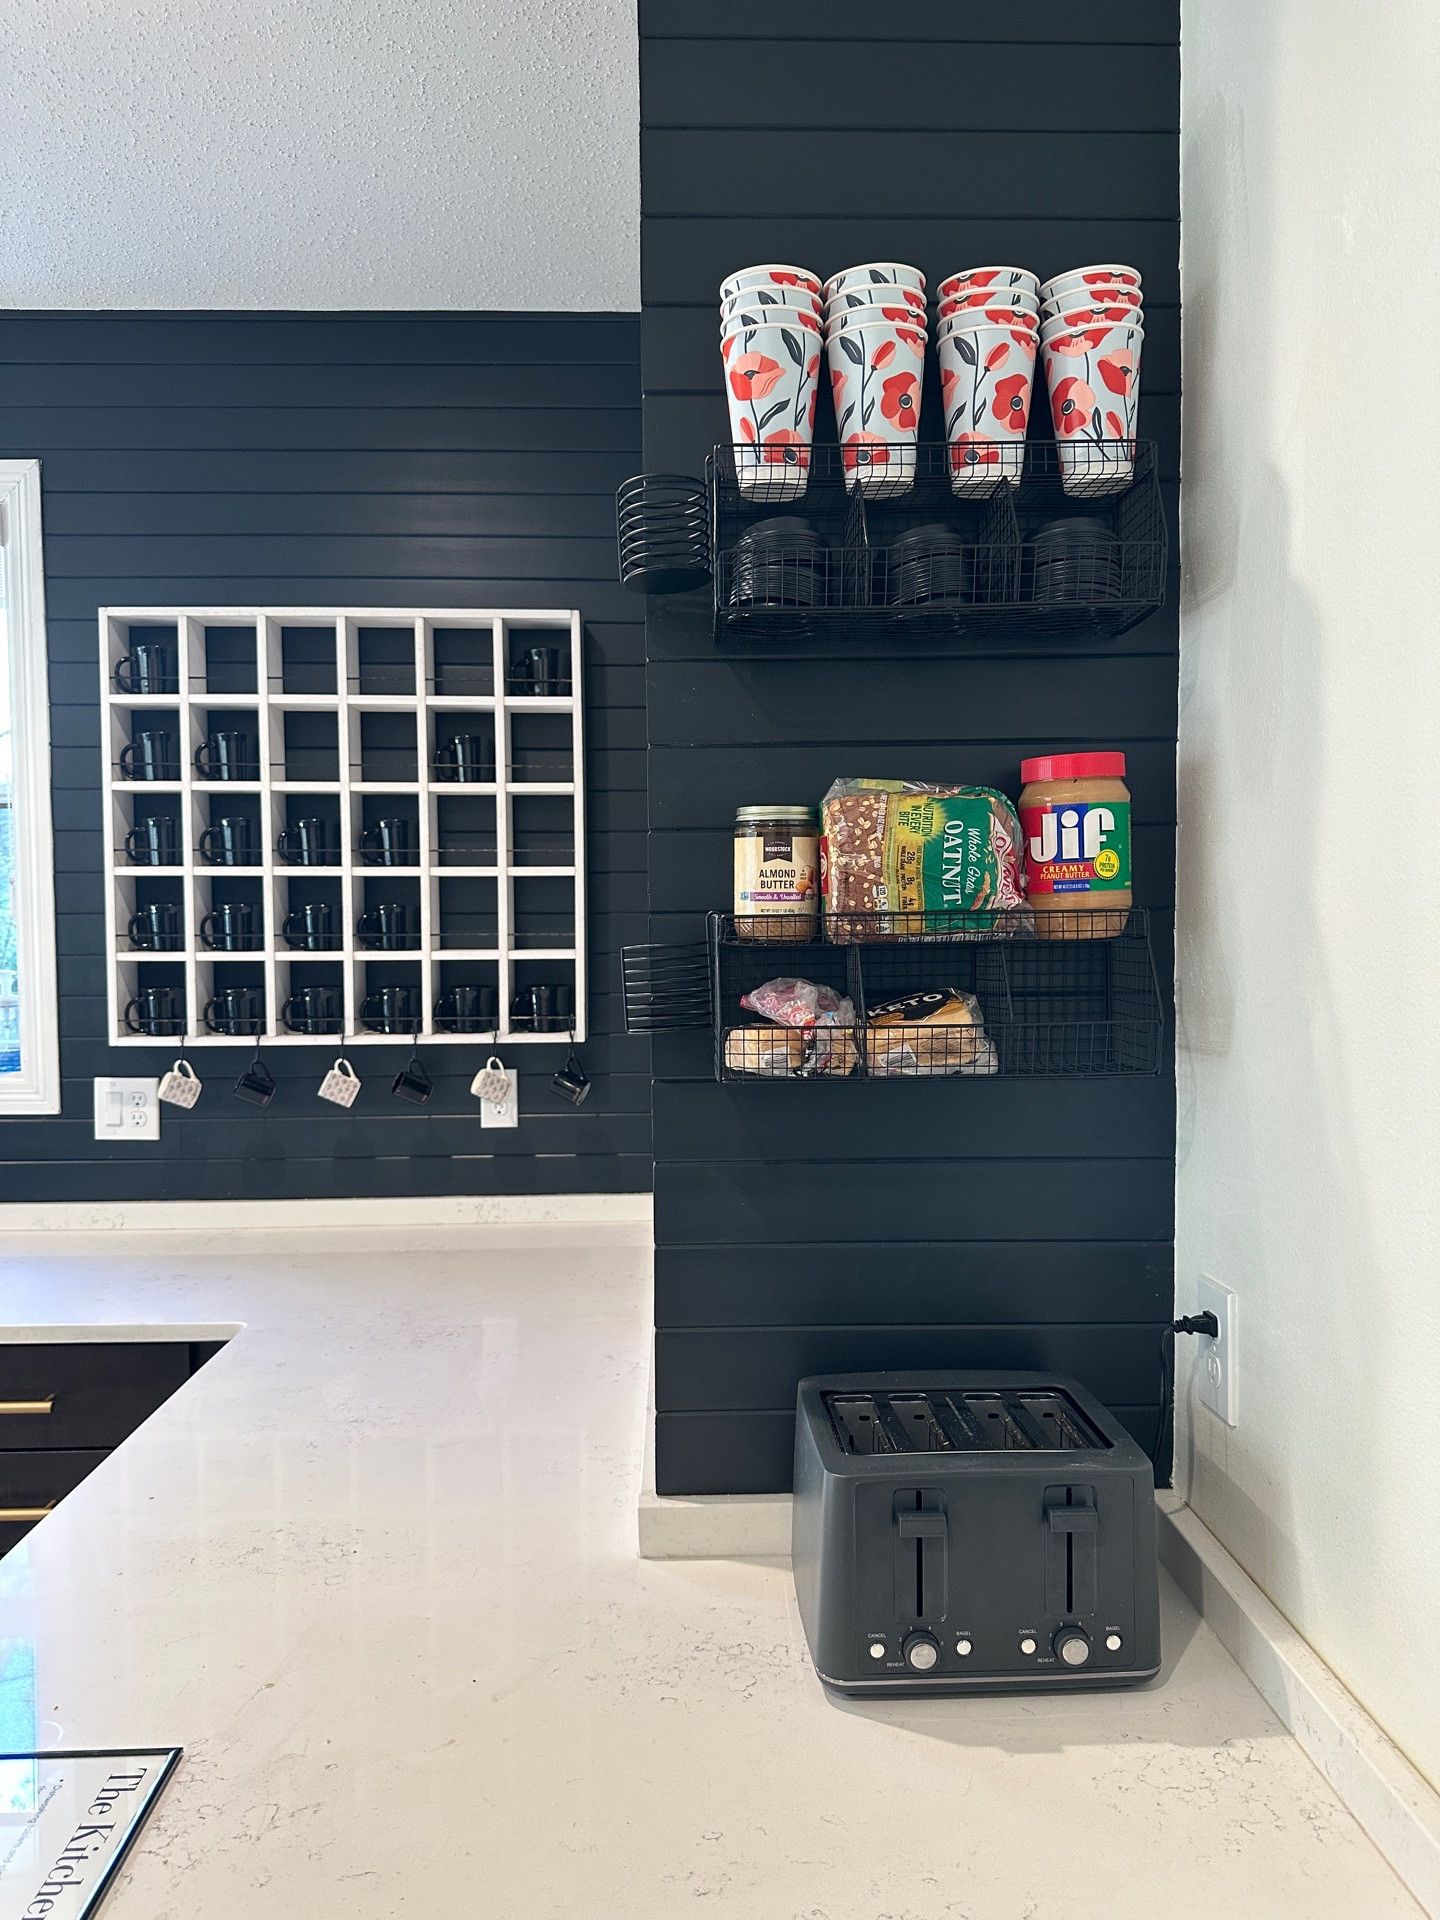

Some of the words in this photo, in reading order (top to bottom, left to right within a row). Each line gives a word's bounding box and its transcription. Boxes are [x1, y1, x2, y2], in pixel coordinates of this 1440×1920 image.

[897, 811, 910, 827] BITE
[909, 811, 922, 834] EVERY
[921, 802, 935, 837] NUTRITION
[967, 827, 982, 863] Whole
[1030, 808, 1115, 863] Jif
[906, 851, 916, 865] 28g
[941, 819, 964, 905] OATNUT
[1043, 864, 1085, 873] CREAMY
[758, 869, 796, 879] ALMOND
[760, 879, 795, 889] BUTTER
[1040, 872, 1064, 880] PEANUT
[1065, 871, 1090, 879] BUTTER
[867, 993, 943, 1016] KETO
[88, 1767, 148, 1816] The
